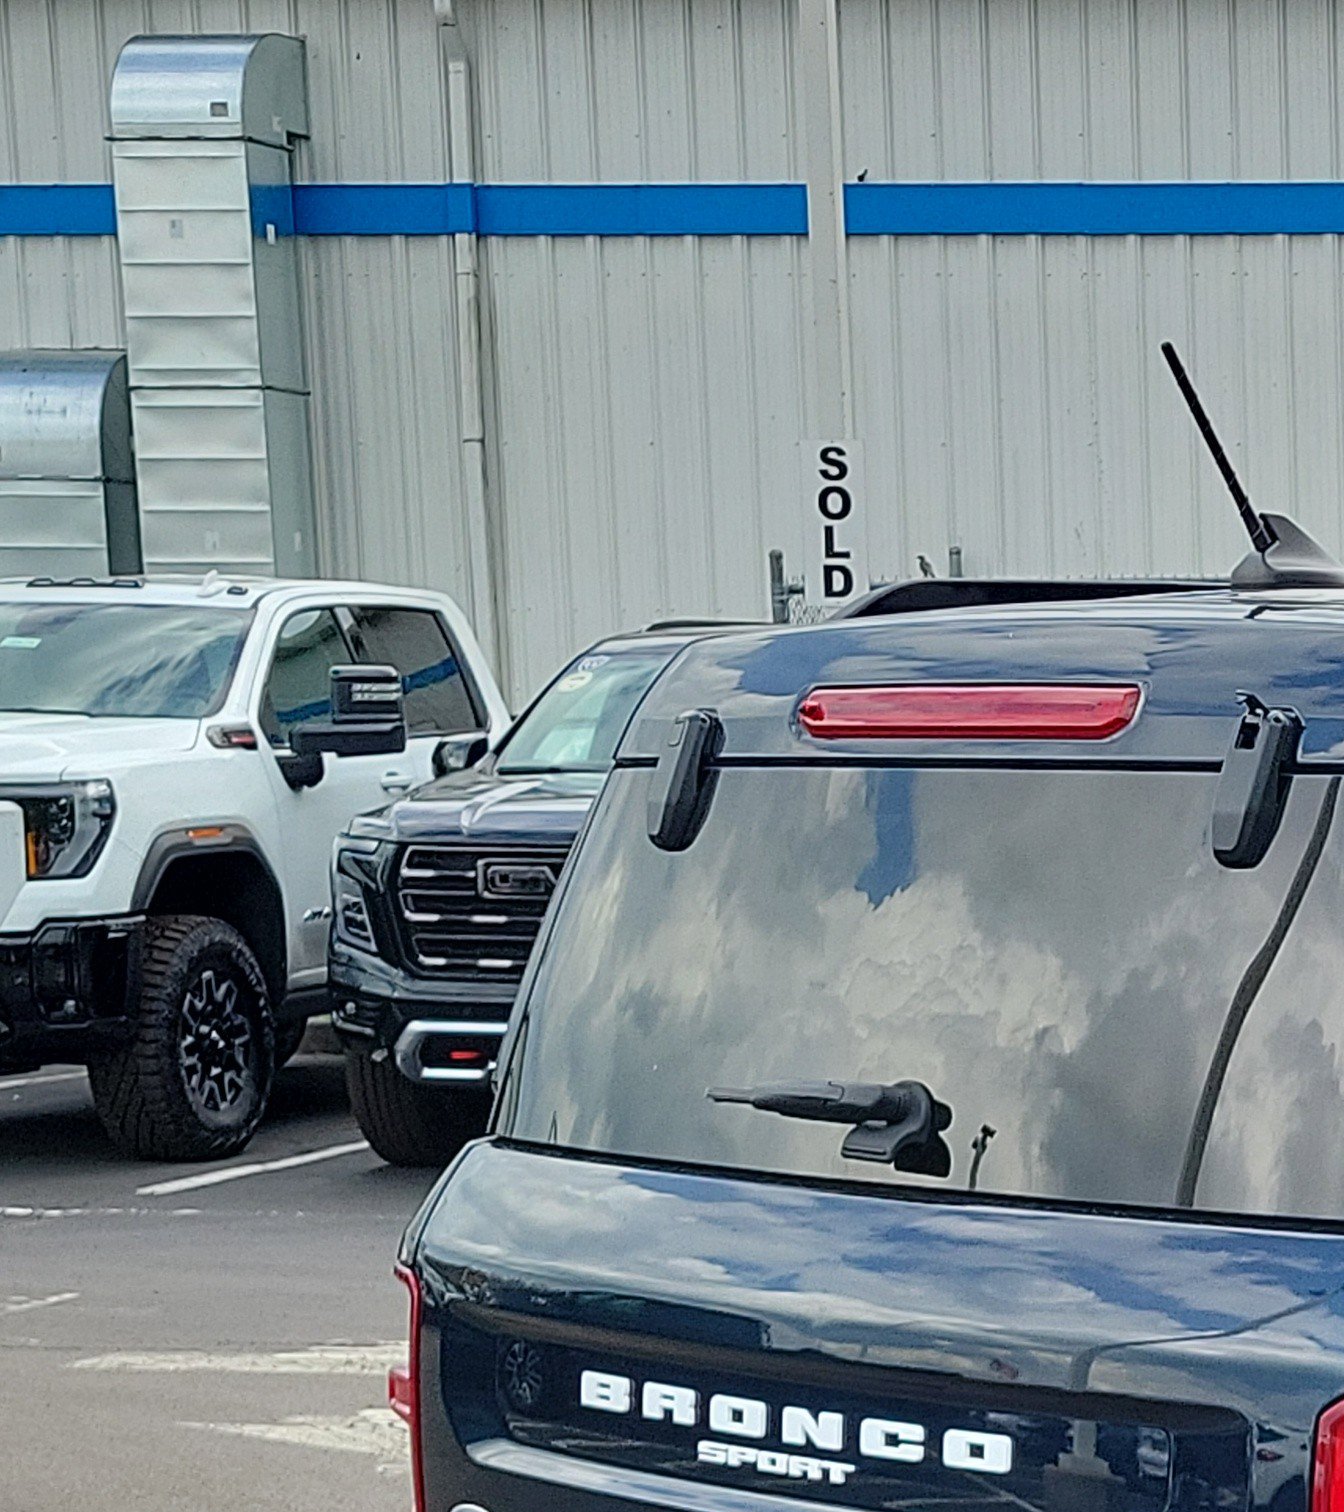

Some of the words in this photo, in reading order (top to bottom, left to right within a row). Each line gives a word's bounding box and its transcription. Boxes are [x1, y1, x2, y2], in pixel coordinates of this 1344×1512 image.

[818, 446, 853, 598] SOLD
[579, 1369, 1014, 1475] BRONCO
[696, 1439, 856, 1485] SPORT
